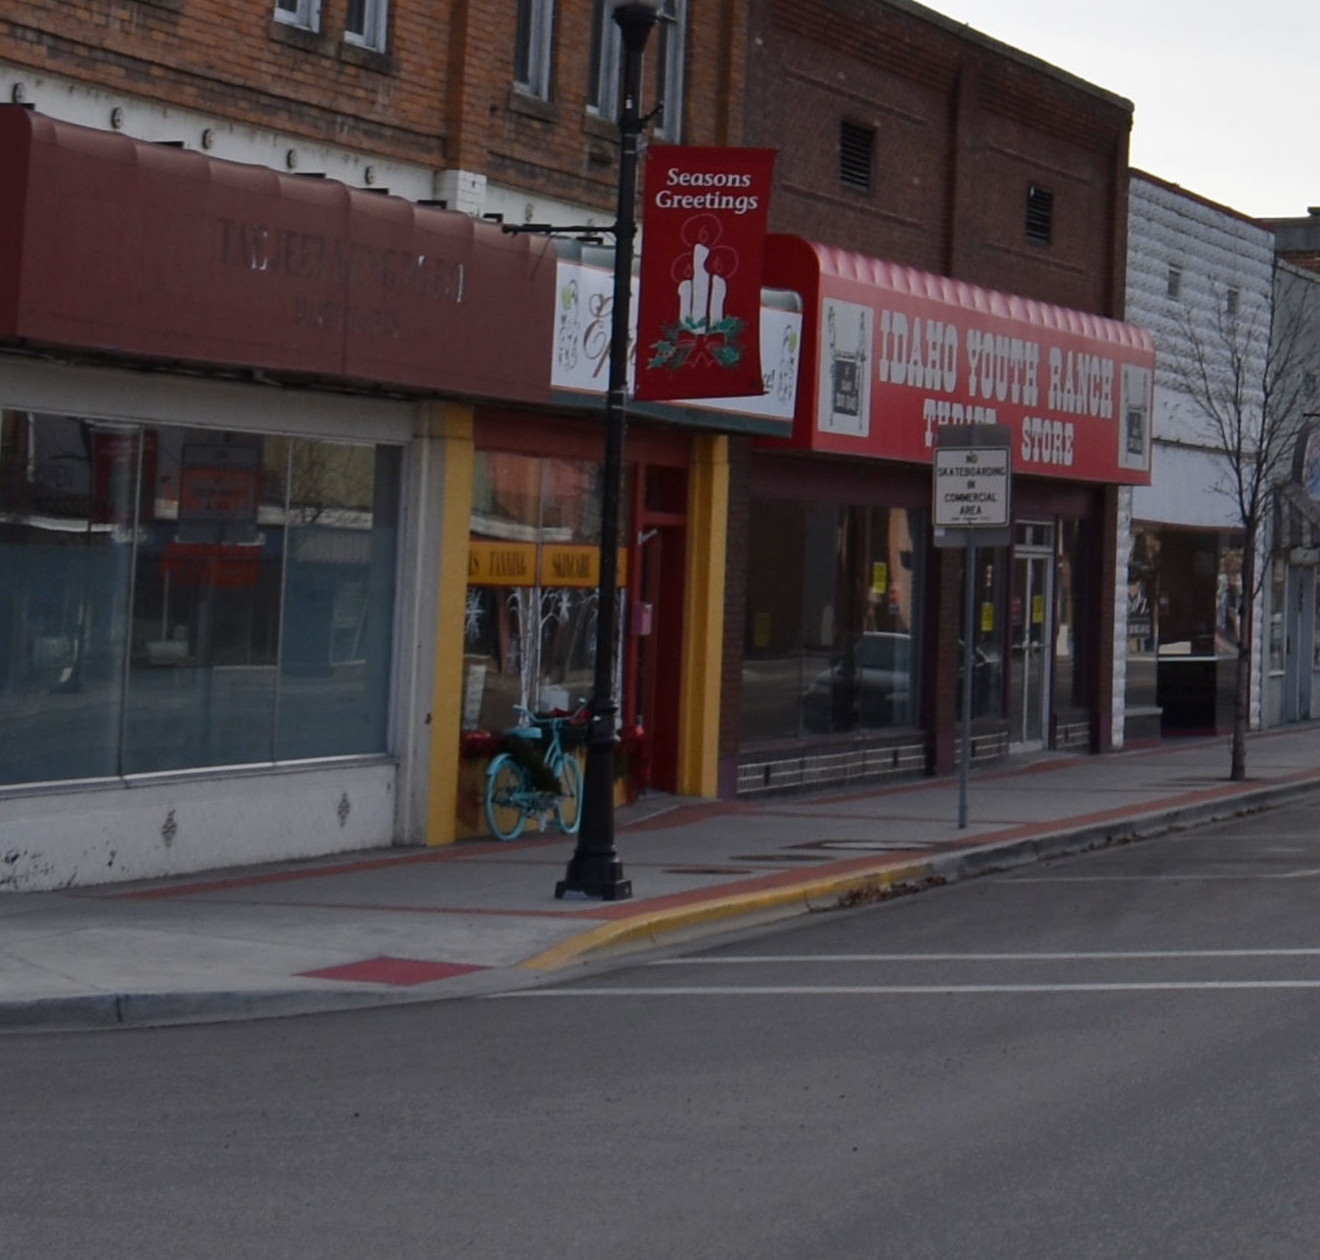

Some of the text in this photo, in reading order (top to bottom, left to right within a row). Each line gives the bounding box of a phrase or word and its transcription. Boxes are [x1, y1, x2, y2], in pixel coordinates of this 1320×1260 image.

[666, 168, 751, 187] Seasons
[655, 190, 758, 214] Greetings
[879, 309, 958, 393] IDAHO
[966, 328, 1039, 407] YOUTH
[1048, 346, 1114, 419] RANCH
[1021, 416, 1074, 466] STORE
[966, 454, 978, 463] NO
[938, 467, 1006, 476] SKATEBOARDING
[967, 480, 975, 489] IN
[944, 493, 997, 502] COMMERCIAL
[959, 505, 982, 515] AREA
